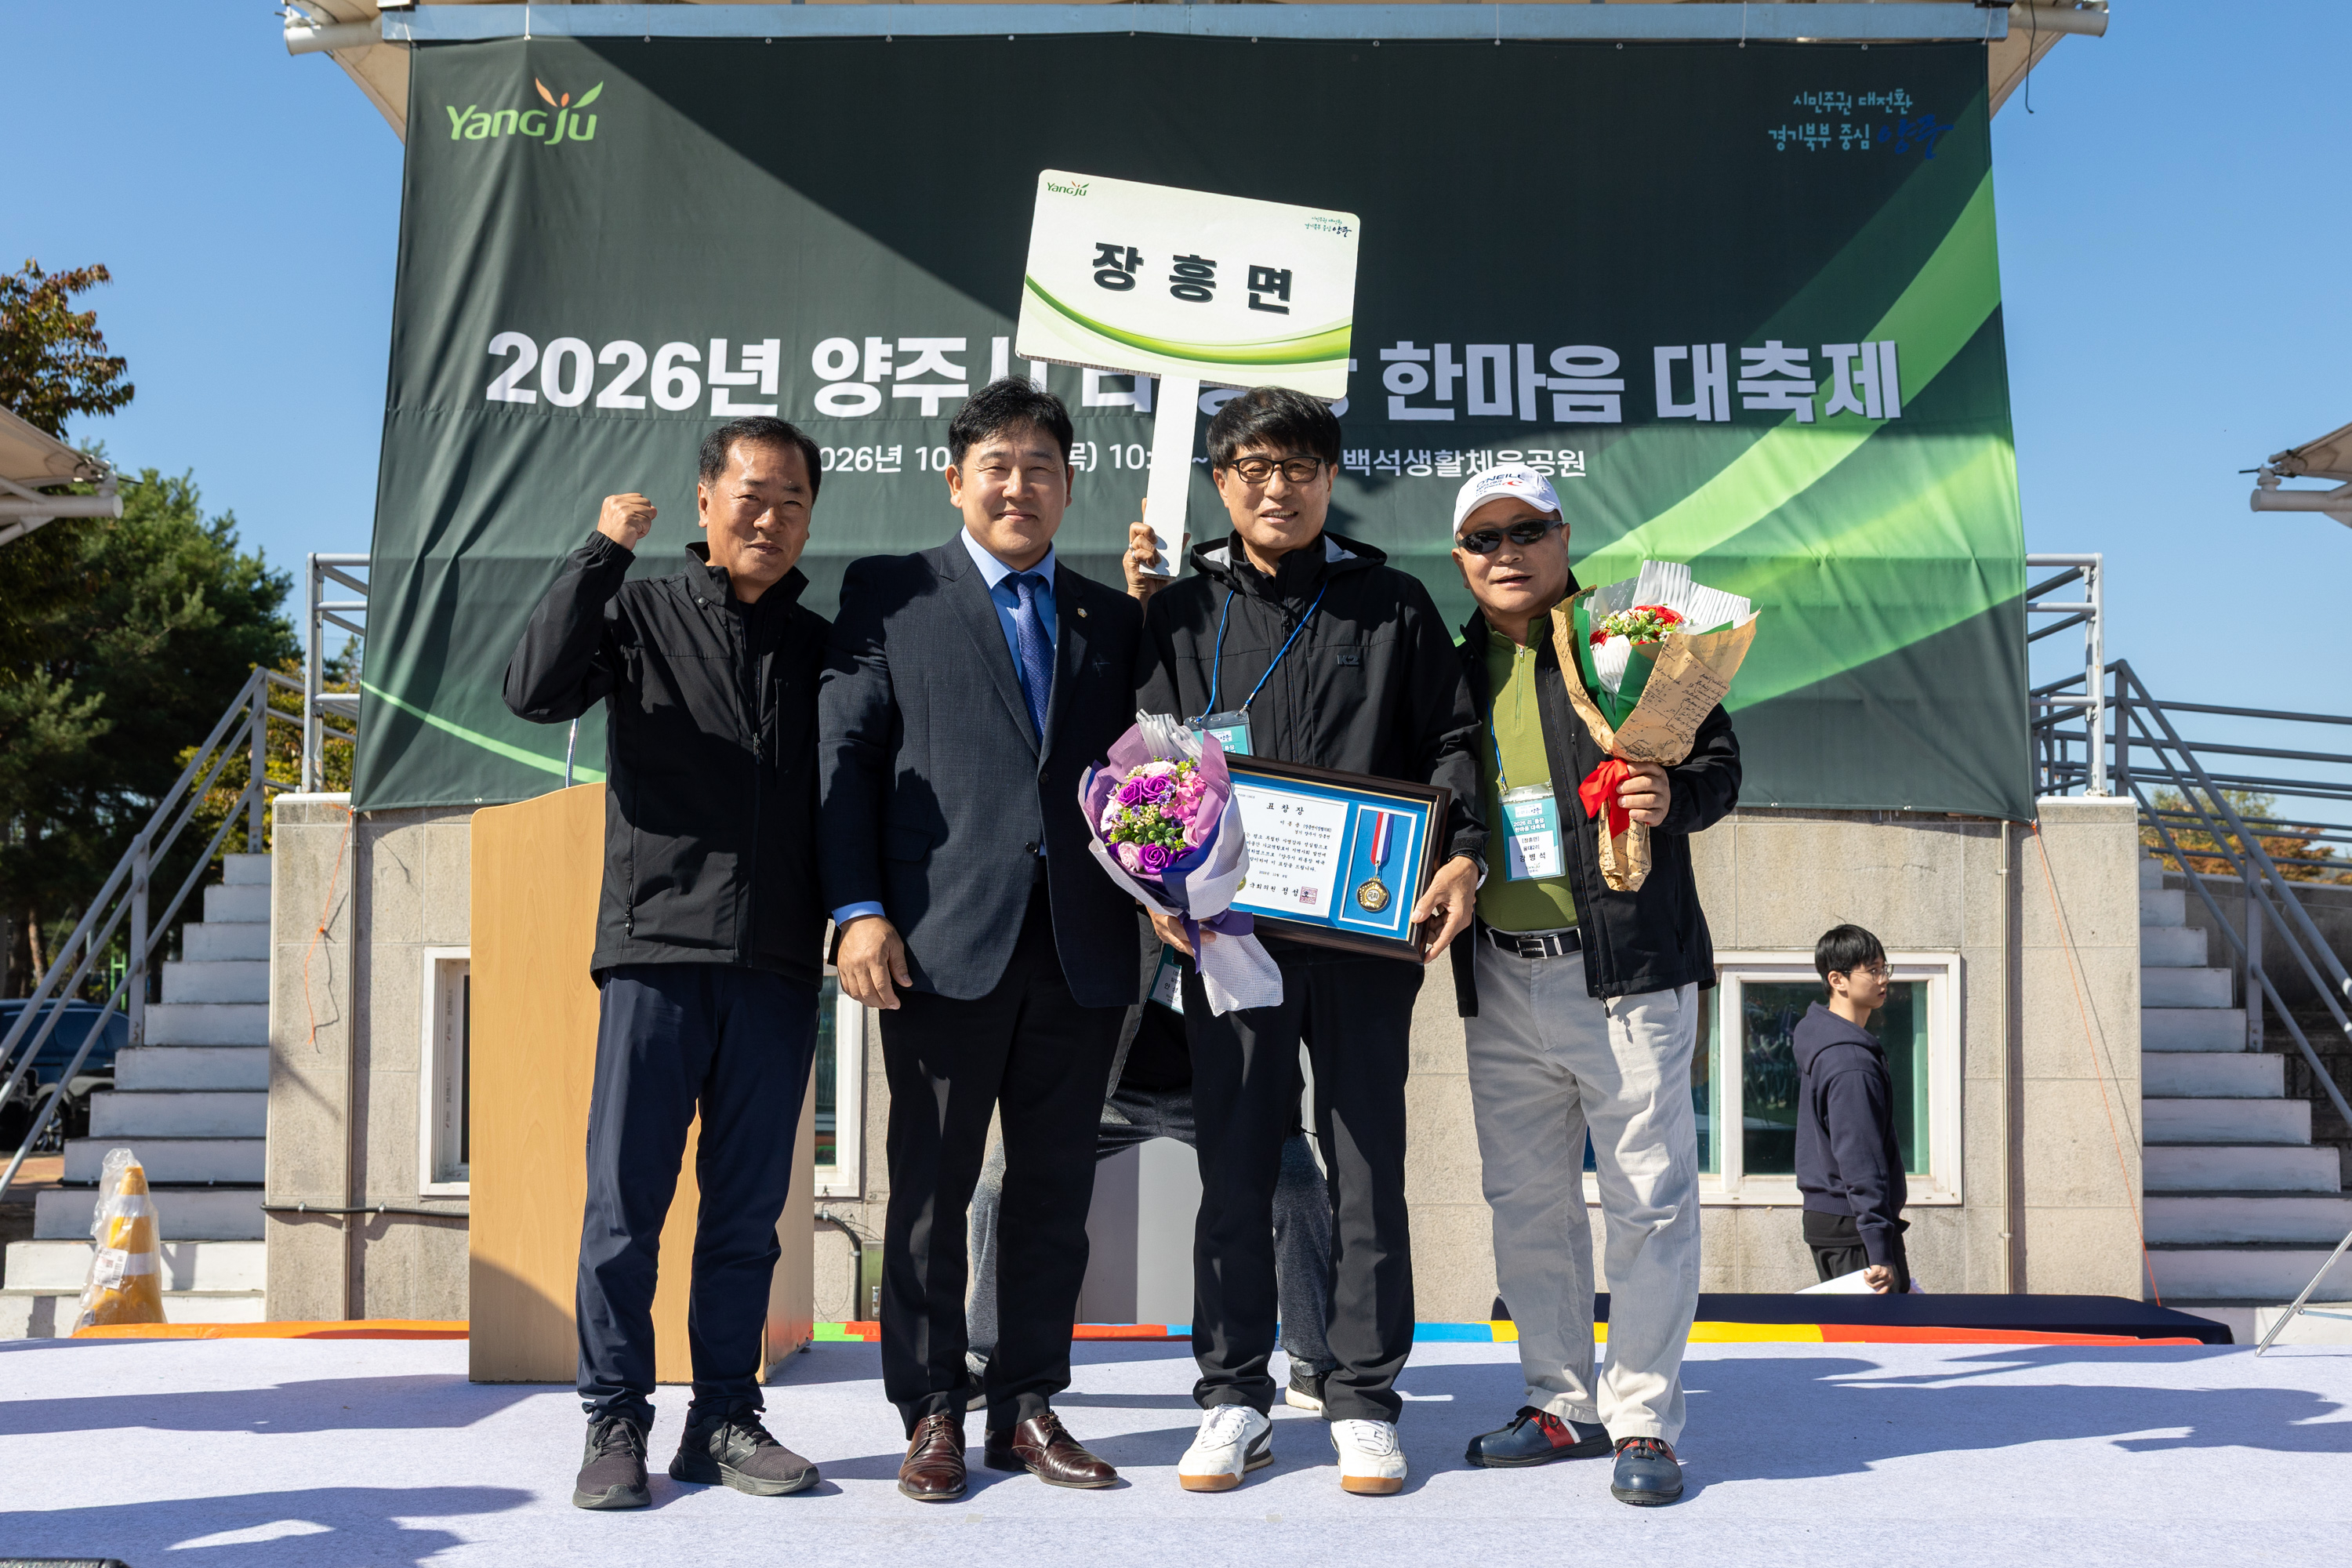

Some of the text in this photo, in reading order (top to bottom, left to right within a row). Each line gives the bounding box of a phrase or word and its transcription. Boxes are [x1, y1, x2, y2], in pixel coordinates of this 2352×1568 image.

[1793, 89, 1913, 115] 시민주권 대전환
[1768, 114, 1955, 160] 경기북부 중심 양주
[486, 331, 781, 417] 2026년
[1380, 340, 1624, 423] 한마음
[1653, 339, 1902, 423] 대축제
[820, 445, 902, 473] 026년
[915, 446, 951, 471] 10
[1337, 655, 1359, 665] K2
